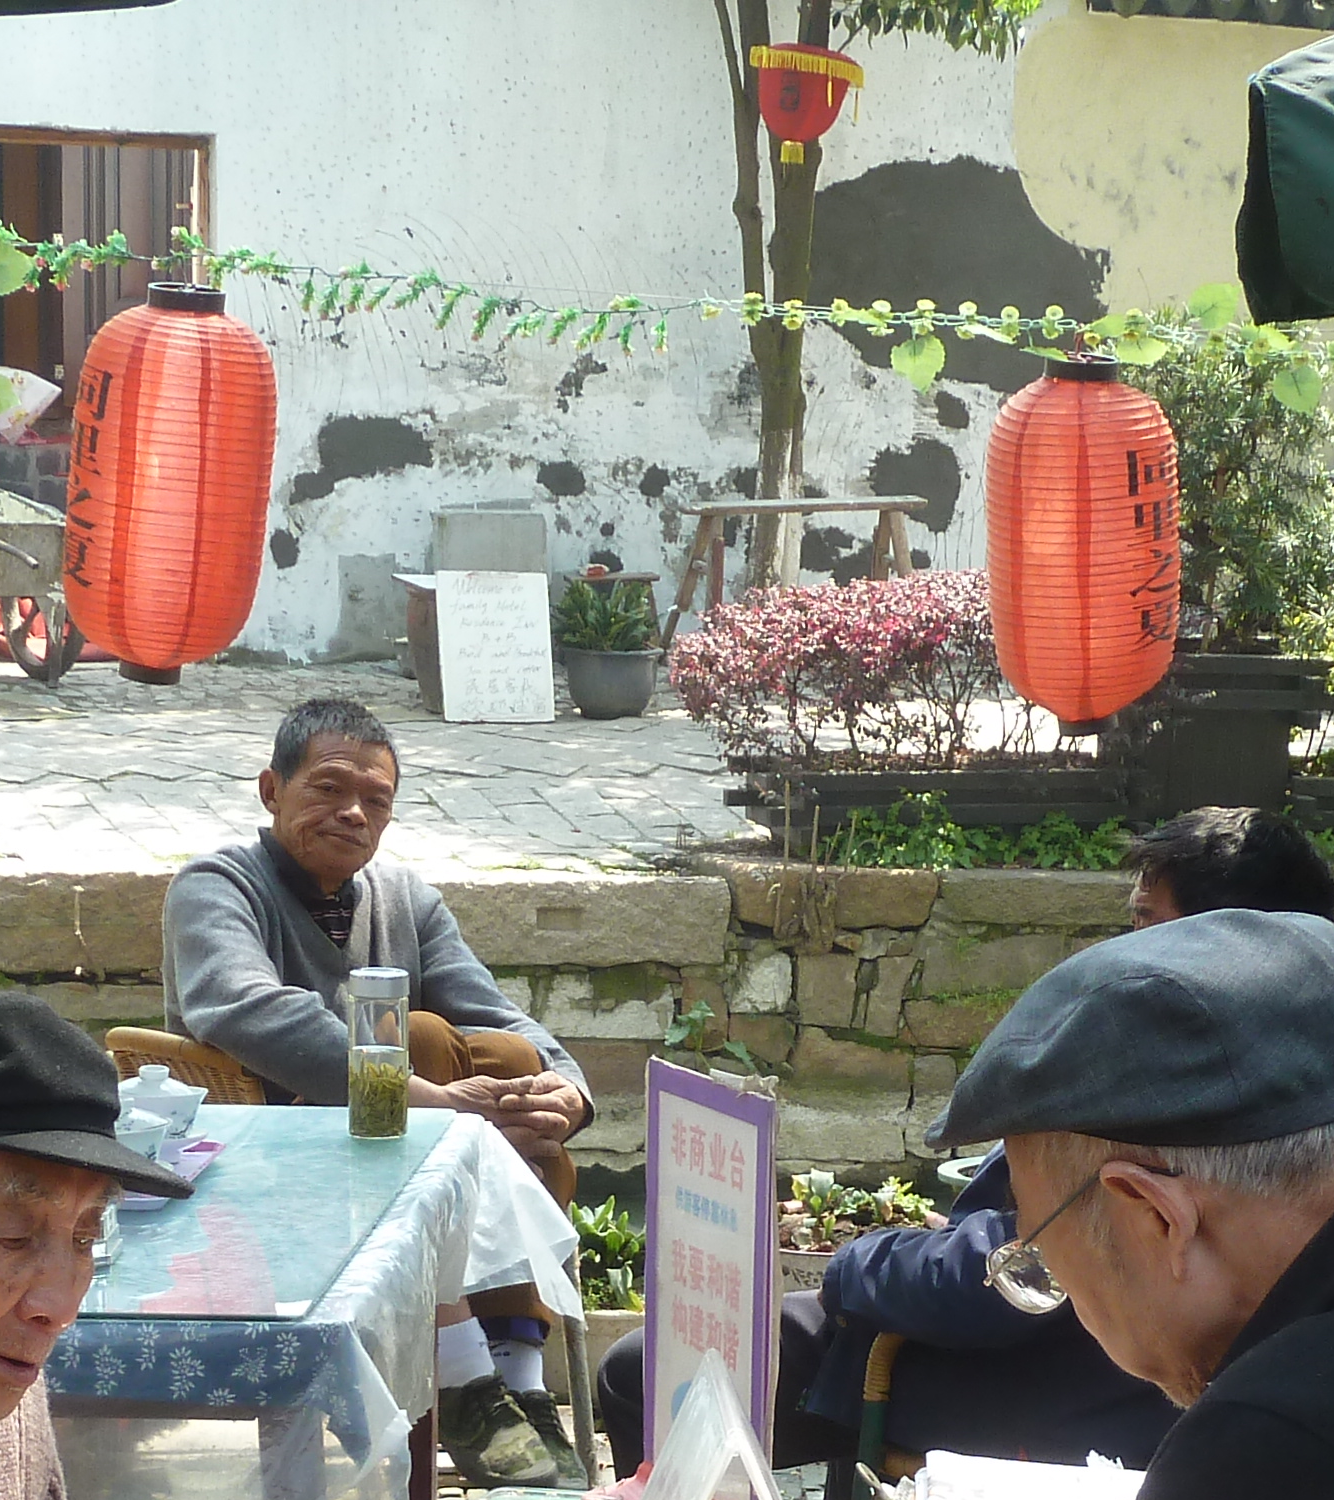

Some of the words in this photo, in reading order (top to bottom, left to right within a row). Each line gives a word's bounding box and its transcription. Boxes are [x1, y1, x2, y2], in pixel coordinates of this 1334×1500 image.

[671, 1117, 746, 1193] 非商业台
[671, 1237, 742, 1313] 我要和谐
